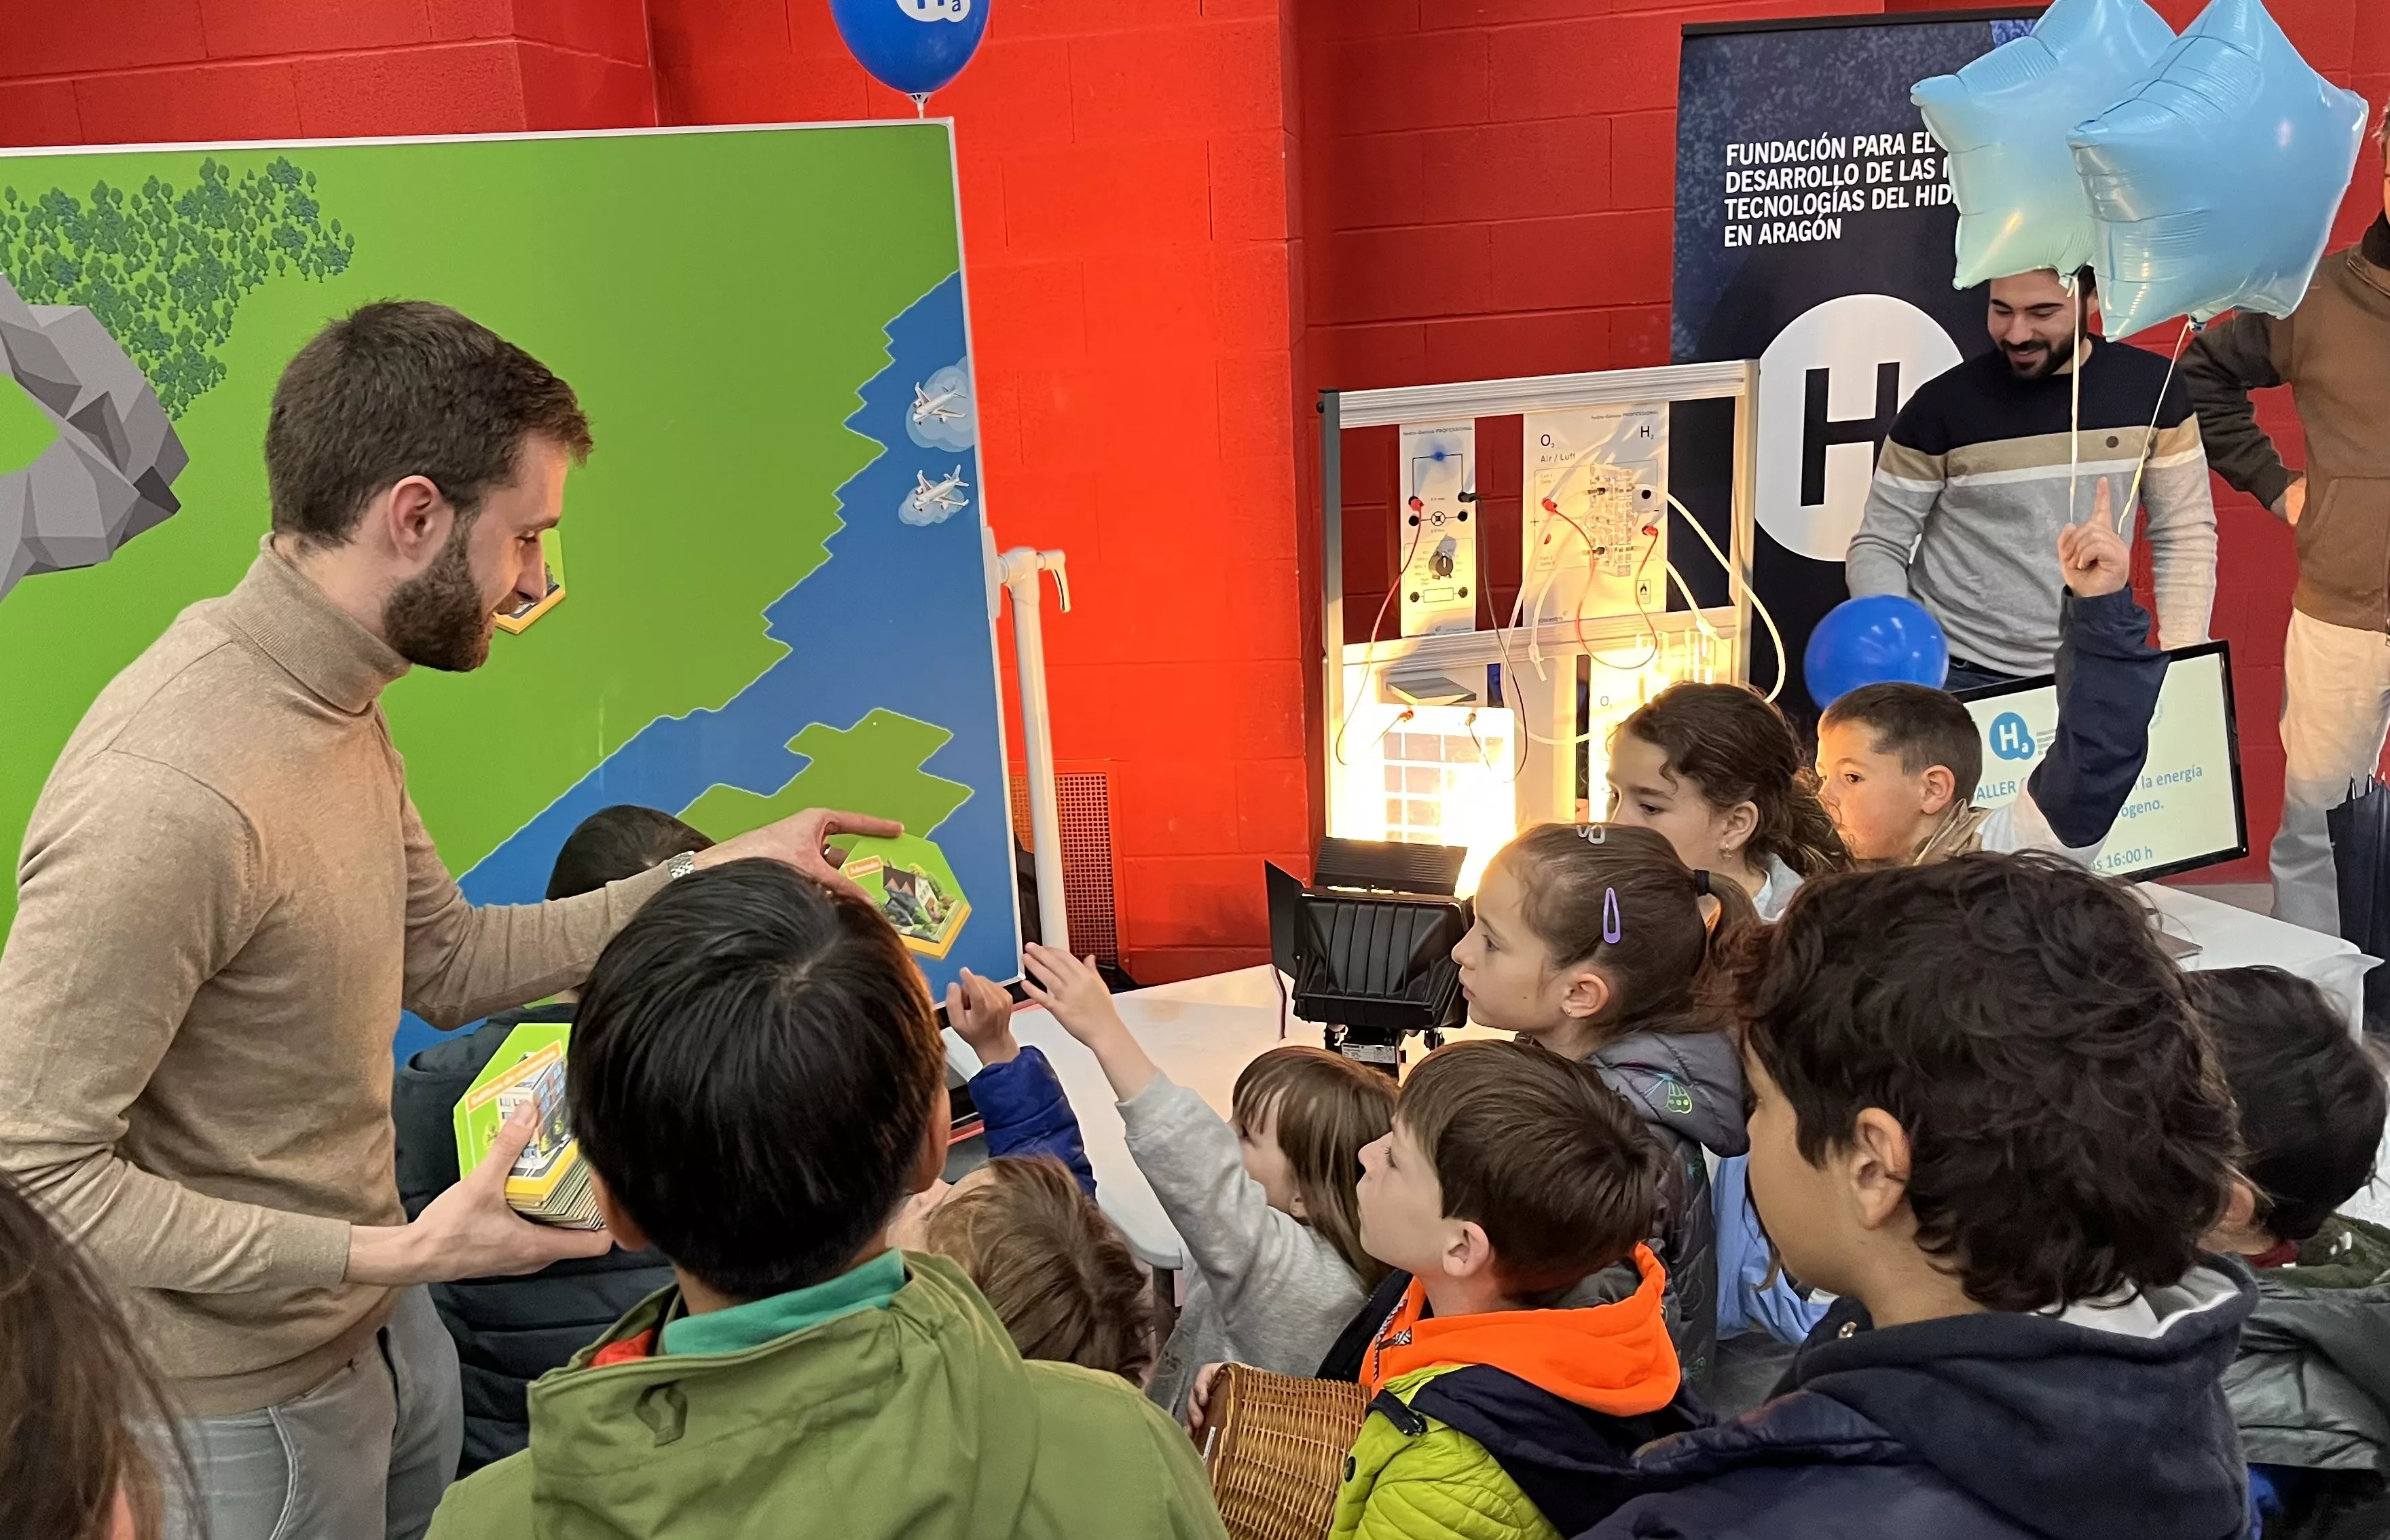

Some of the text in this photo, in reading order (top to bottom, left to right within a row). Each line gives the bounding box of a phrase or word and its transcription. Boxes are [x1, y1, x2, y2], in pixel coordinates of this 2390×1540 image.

[1726, 132, 1936, 166] FUNDACIÓN PARA EL
[1725, 163, 1860, 194] DESARROLLO
[1866, 160, 1894, 184] DE
[1899, 158, 1936, 181] LAS
[1724, 184, 1952, 220] TECNOLOGÍAS DEL HID
[1724, 213, 1842, 247] EN ARAGÓN
[1560, 453, 1576, 461] Luft
[1999, 722, 2029, 754] Ha
[1977, 780, 2017, 801] ALLER
[2141, 775, 2153, 789] la
[2156, 764, 2203, 786] energía
[2107, 848, 2141, 868] 16:00
[2144, 846, 2153, 860] h
